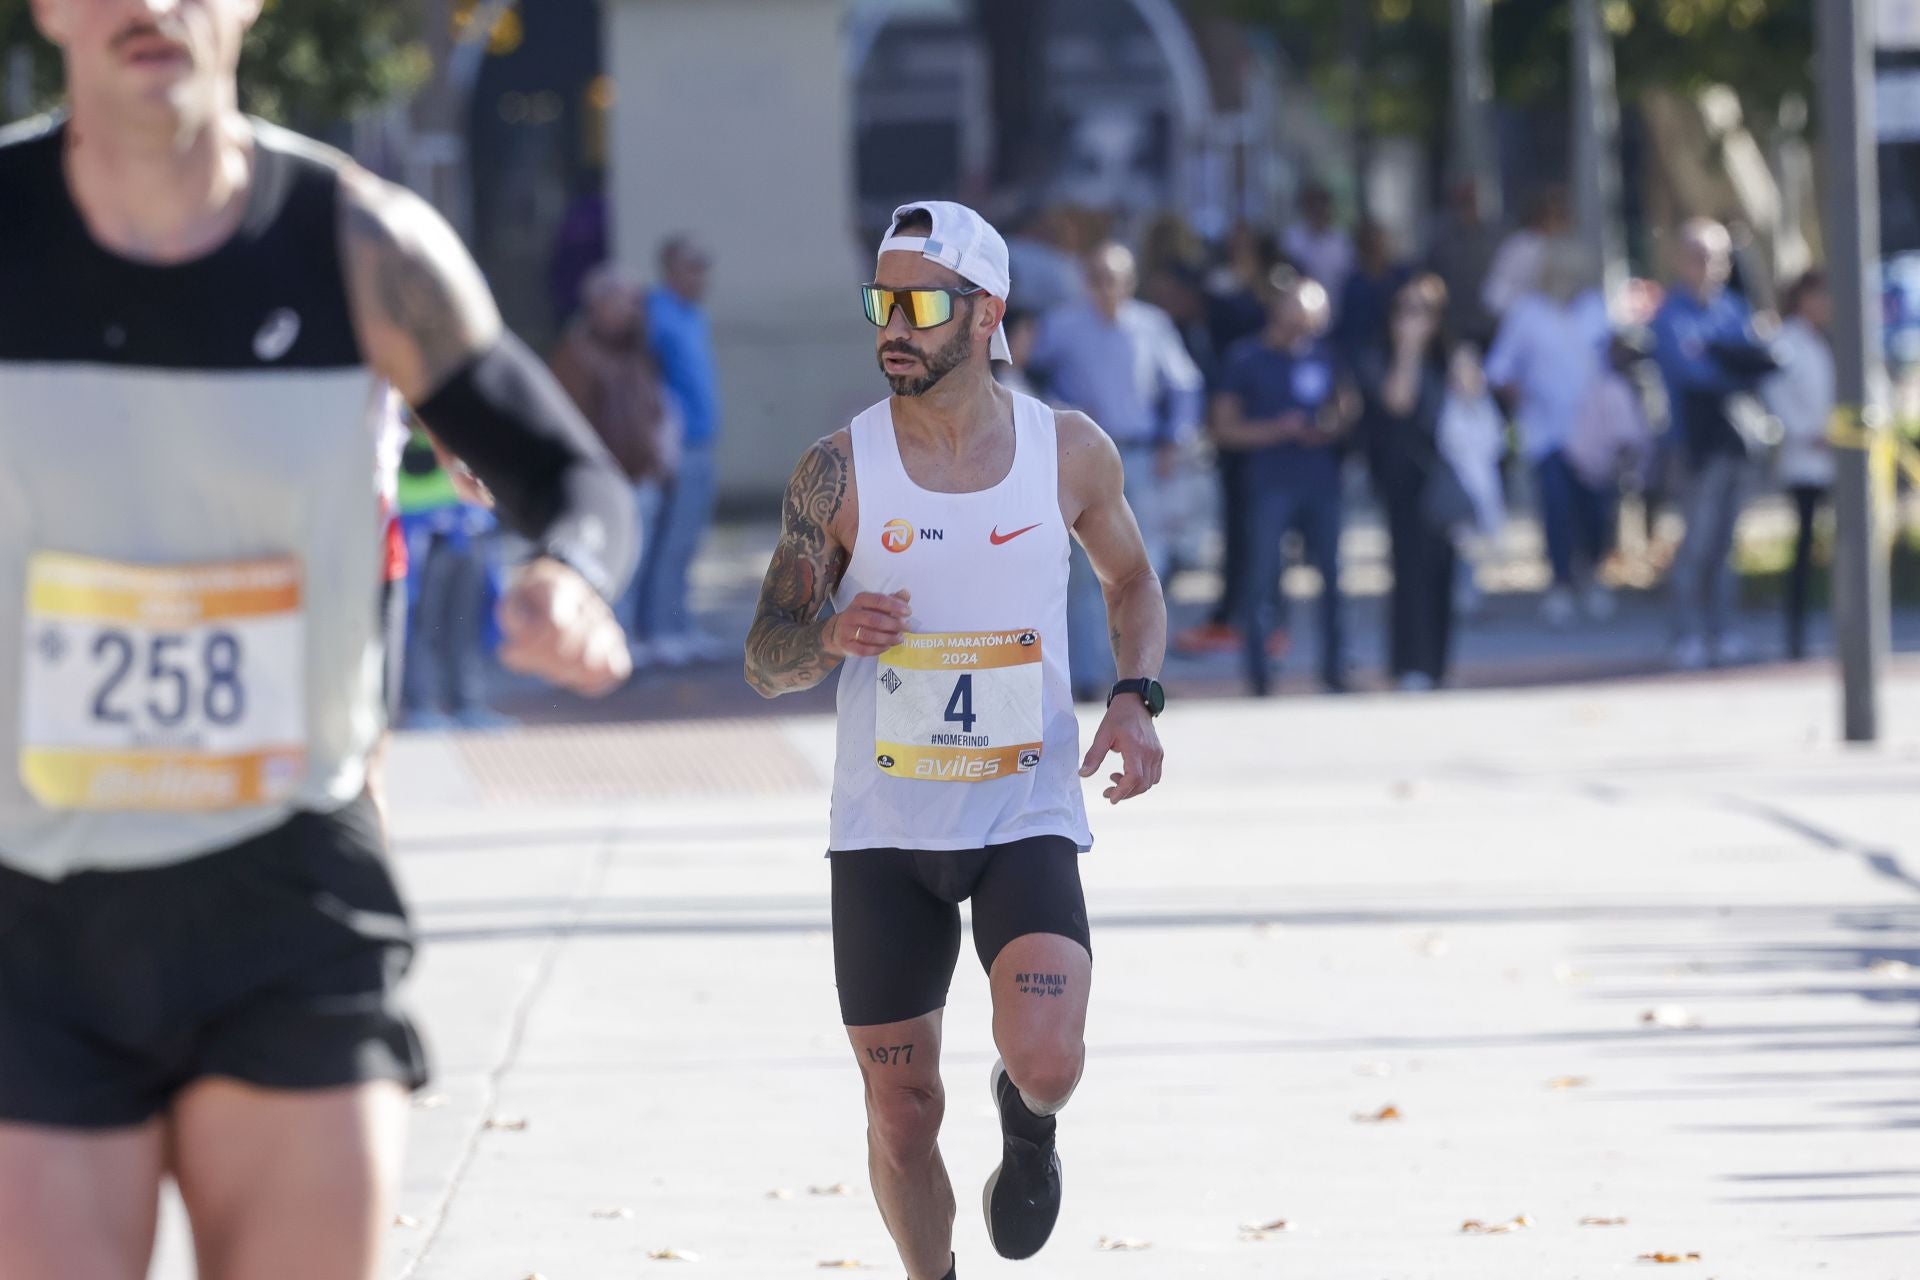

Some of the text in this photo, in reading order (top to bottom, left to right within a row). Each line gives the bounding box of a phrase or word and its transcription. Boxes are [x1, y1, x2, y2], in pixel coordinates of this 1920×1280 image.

[919, 528, 944, 541] NN
[911, 638, 945, 649] MEDIA
[947, 632, 1003, 648] MARATÓN
[942, 652, 978, 665] 2024
[90, 631, 244, 726] 258
[944, 673, 976, 733] 4
[931, 733, 989, 747] #NOMERINDO
[915, 755, 1002, 777] avilés
[1015, 973, 1067, 986] MY FAMILY
[1030, 986, 1046, 997] my
[1047, 985, 1064, 997] life
[866, 1044, 915, 1065] 1977
